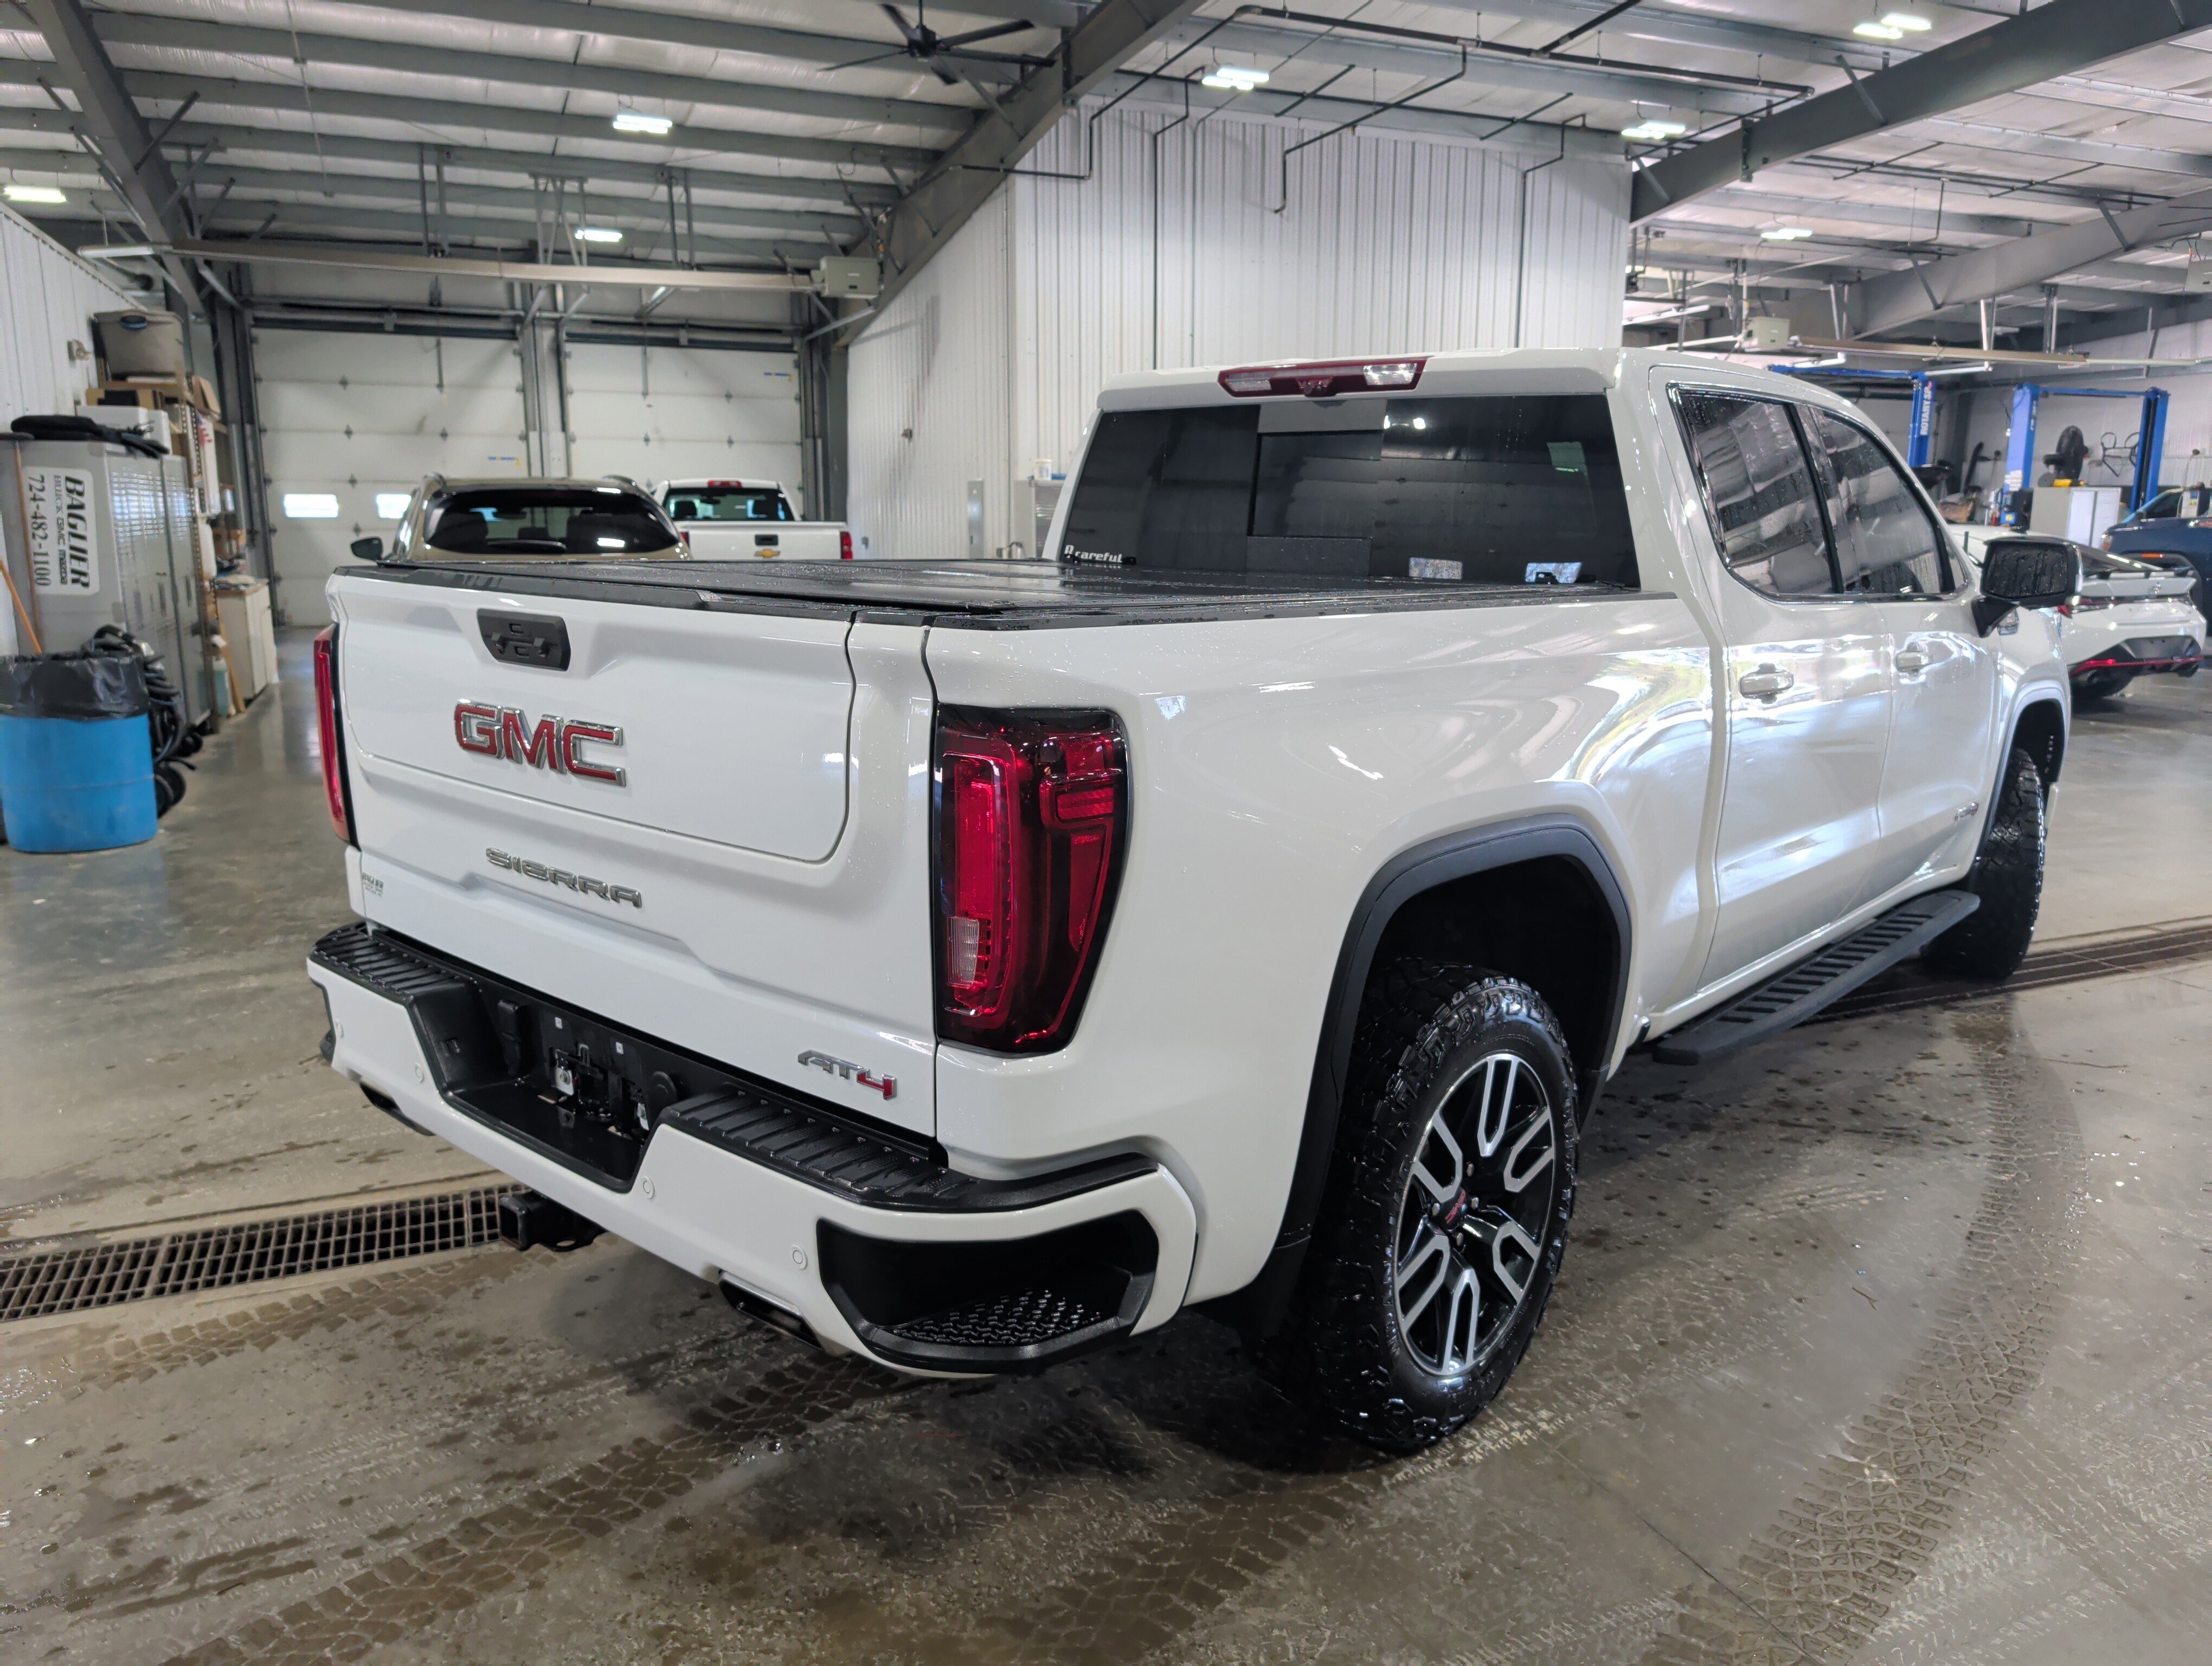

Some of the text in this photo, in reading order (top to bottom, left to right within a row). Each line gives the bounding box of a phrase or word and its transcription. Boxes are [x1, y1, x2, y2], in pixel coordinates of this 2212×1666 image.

[28, 473, 52, 586] 724-482-1100
[65, 475, 90, 588] BAGLIER
[1075, 550, 1122, 563] careful
[454, 698, 627, 788] GMC
[486, 847, 642, 909] SIERRA
[798, 1049, 897, 1105] AT4
